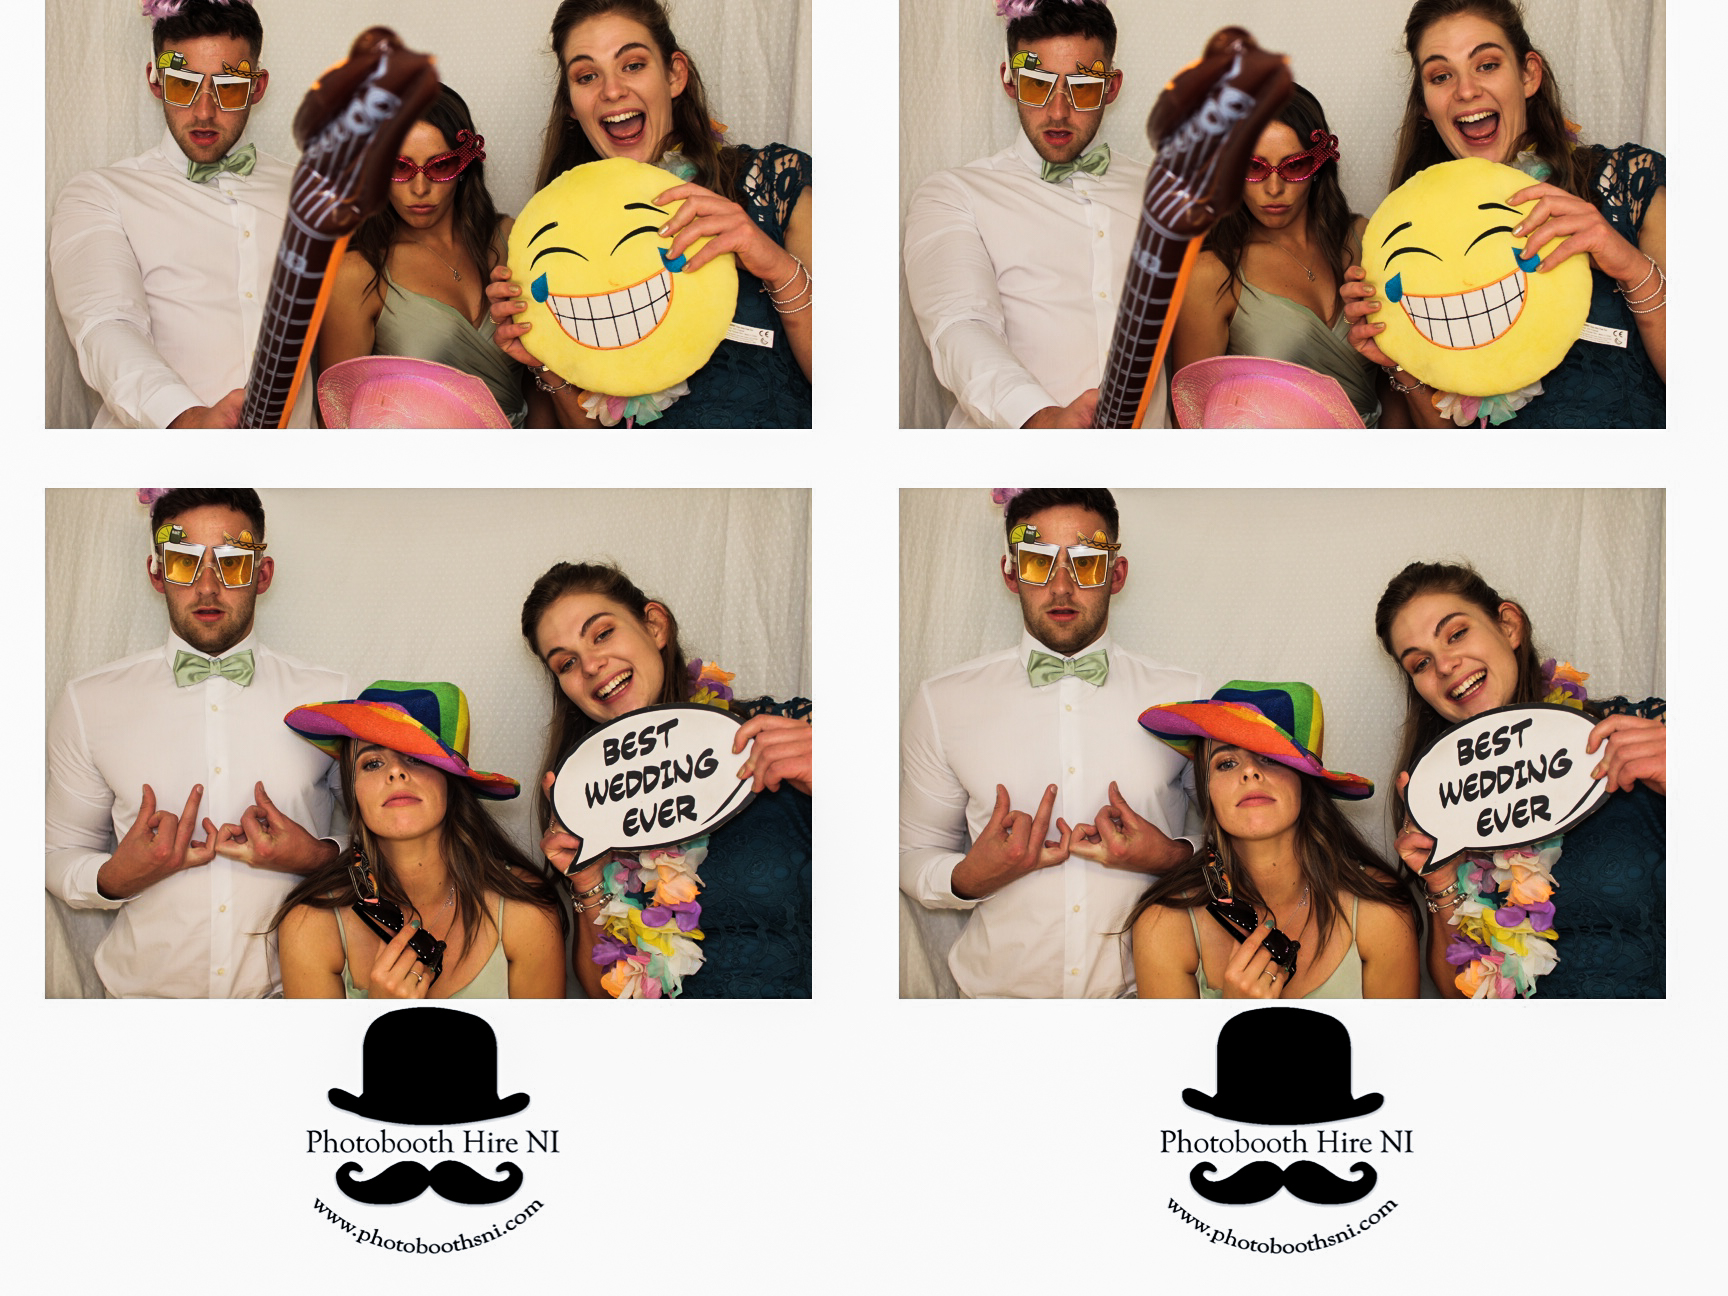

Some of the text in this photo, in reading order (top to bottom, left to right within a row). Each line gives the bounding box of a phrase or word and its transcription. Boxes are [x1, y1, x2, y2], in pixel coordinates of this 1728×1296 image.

[602, 717, 680, 767] BEST
[1456, 717, 1534, 767] BEST
[584, 747, 720, 809] WEDDING
[1438, 747, 1574, 809] WEDDING
[622, 794, 698, 838] EVER
[1476, 794, 1552, 838] EVER
